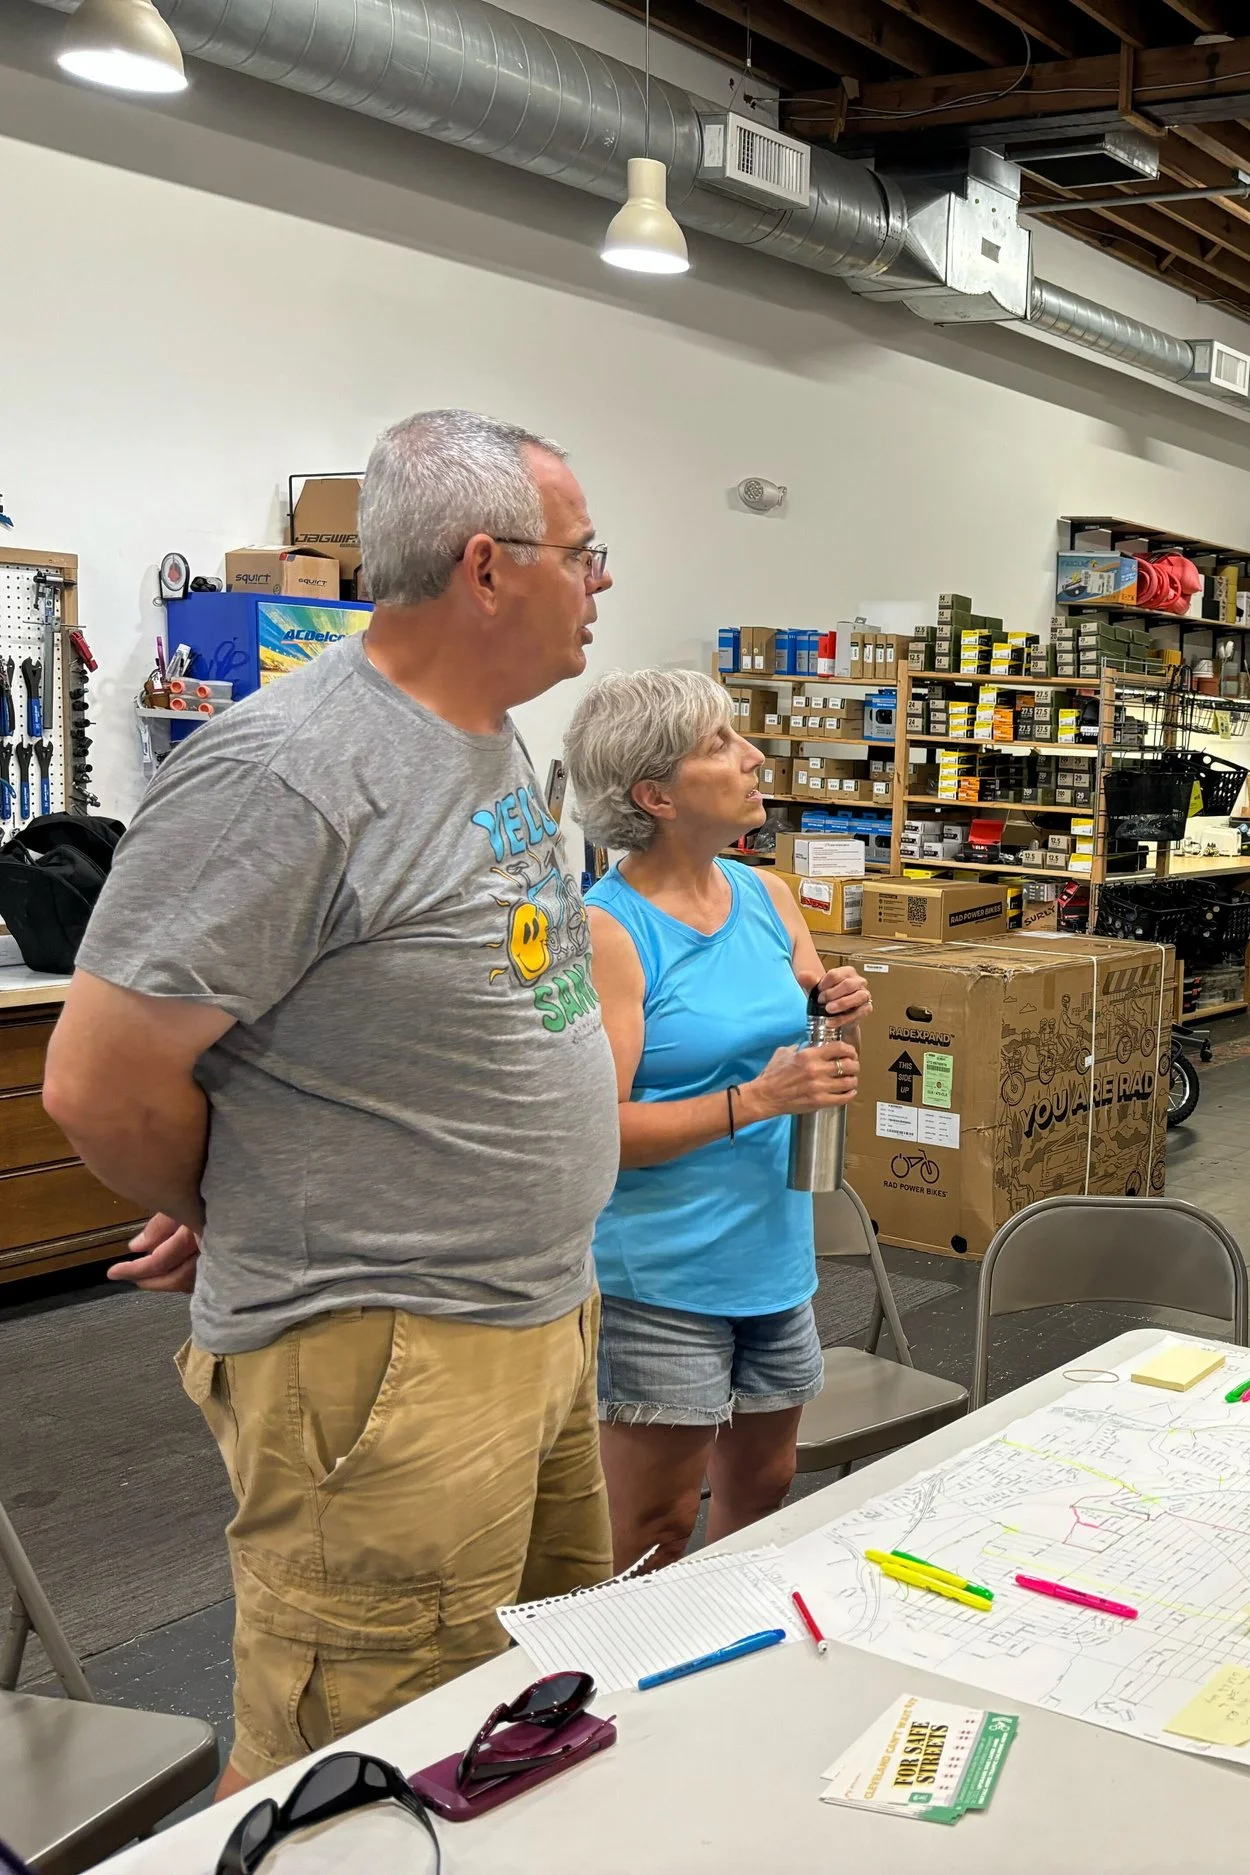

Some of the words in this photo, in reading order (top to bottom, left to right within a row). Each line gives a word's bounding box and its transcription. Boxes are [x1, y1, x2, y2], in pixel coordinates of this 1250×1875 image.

[295, 533, 359, 543] JAGWIR
[235, 573, 271, 585] squirt
[298, 577, 327, 586] squirt
[914, 626, 925, 634] 12.5
[909, 653, 920, 661] 12.5
[1036, 690, 1049, 698] 27.5
[1021, 707, 1033, 715] 27.5
[950, 914, 963, 924] RAD
[963, 909, 984, 921] POWER
[984, 905, 1001, 915] BIKES
[1024, 906, 1055, 926] SURLY
[889, 1026, 951, 1047] RADEXPAND
[899, 1061, 912, 1070] THIS
[898, 1073, 912, 1082] SIDE
[901, 1086, 910, 1094] UP
[1019, 1089, 1069, 1139] YOU
[1072, 1074, 1114, 1116] ARE
[1117, 1070, 1155, 1103] RAD
[883, 1180, 898, 1189] RAD
[900, 1183, 925, 1194] POWER
[926, 1187, 947, 1198] BIKES
[904, 1721, 930, 1755] SAFE
[916, 1724, 949, 1784] STREETS
[864, 1755, 892, 1800] CLEVELAND
[893, 1758, 920, 1786] FOR
